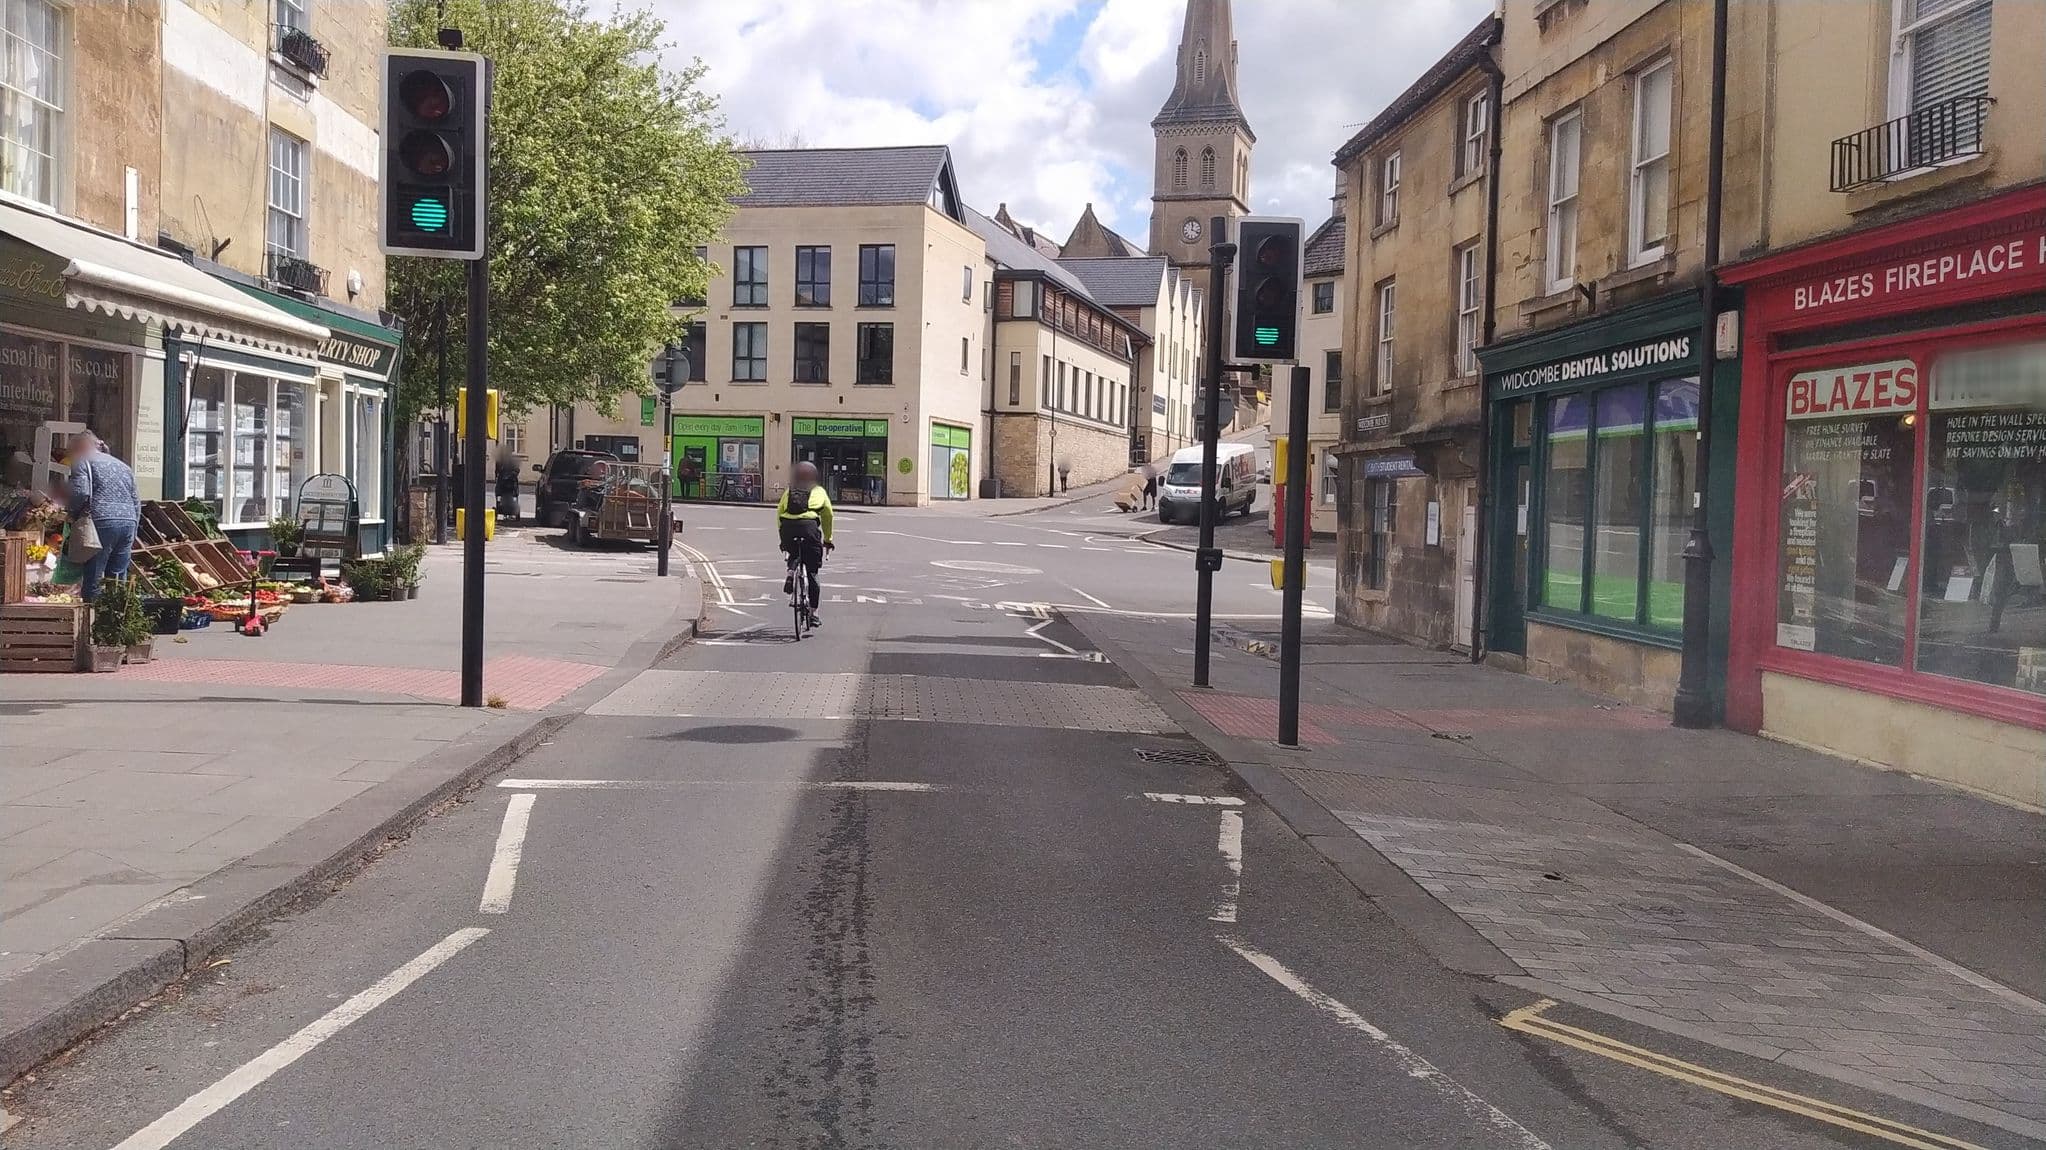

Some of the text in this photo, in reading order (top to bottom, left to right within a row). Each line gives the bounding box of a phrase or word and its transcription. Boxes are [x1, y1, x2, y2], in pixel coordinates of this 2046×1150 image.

[1794, 272, 1873, 311] BLAZES
[1885, 240, 2024, 293] FIREPLACE
[316, 337, 381, 368] ERTY SHOP
[1501, 337, 1690, 391] WIDCOMBE DENTAL SOLUTIONS
[1791, 367, 1917, 415] BLAZES
[797, 421, 884, 434] The co-operative food
[1946, 417, 1966, 428] HOLE
[1968, 416, 1979, 427] IN
[1980, 415, 1997, 427] THE
[1999, 414, 2023, 426] WALL
[711, 423, 721, 433] day
[1841, 422, 1870, 434] SURVEY
[1842, 435, 1878, 447] AVAILABLE
[1946, 431, 1981, 443] BESPOKE
[1982, 430, 2014, 443] DESIGN
[1870, 448, 1892, 460] SLATE
[1946, 447, 1961, 458] VAT
[1962, 446, 1997, 458] SAVINGS
[1997, 446, 2012, 458] ON
[2013, 445, 2038, 457] NEW
